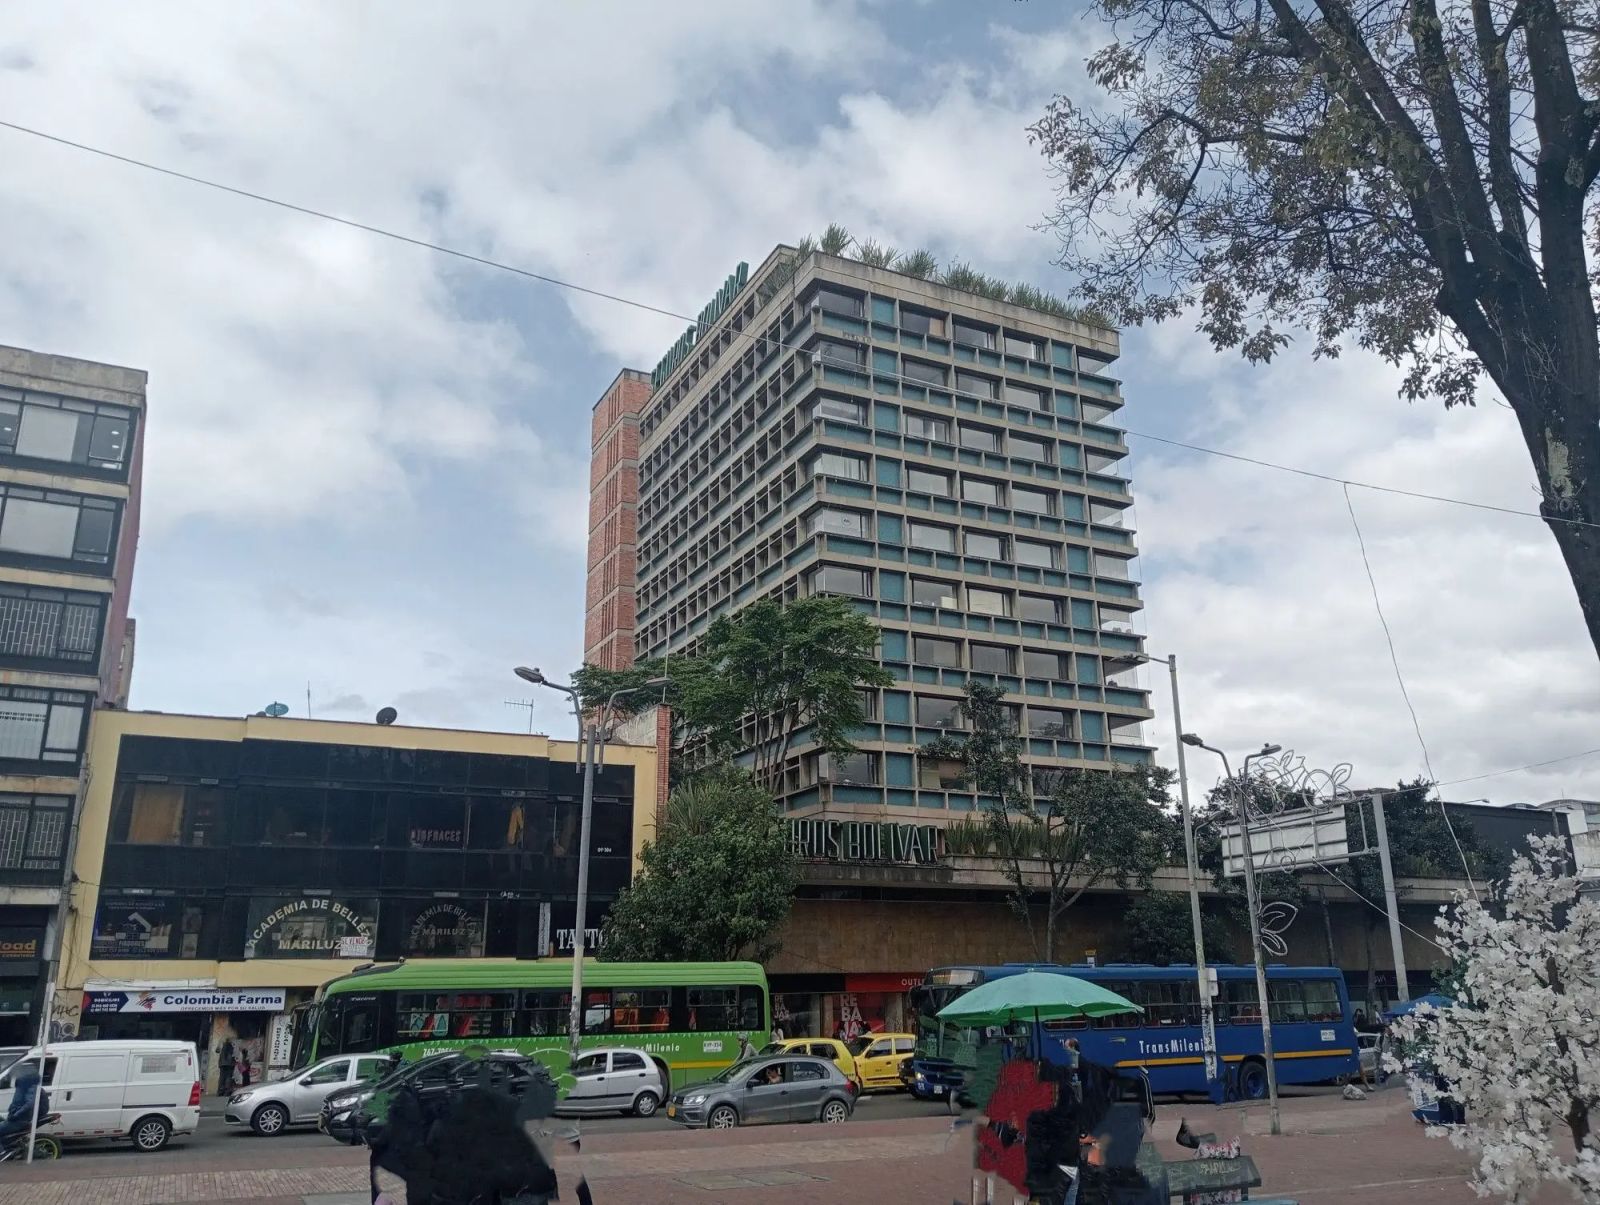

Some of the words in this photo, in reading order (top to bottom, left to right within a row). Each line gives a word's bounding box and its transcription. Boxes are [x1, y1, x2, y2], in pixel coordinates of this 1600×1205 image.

[849, 822, 938, 862] BOLIVAR
[246, 900, 308, 949] ACADEMIA
[311, 899, 329, 910] DE
[278, 940, 342, 950] MARILUZ
[163, 994, 234, 1005] Colombia
[237, 994, 282, 1005] Farma
[841, 1007, 863, 1021] BA
[1139, 1039, 1204, 1054] TransMileni
